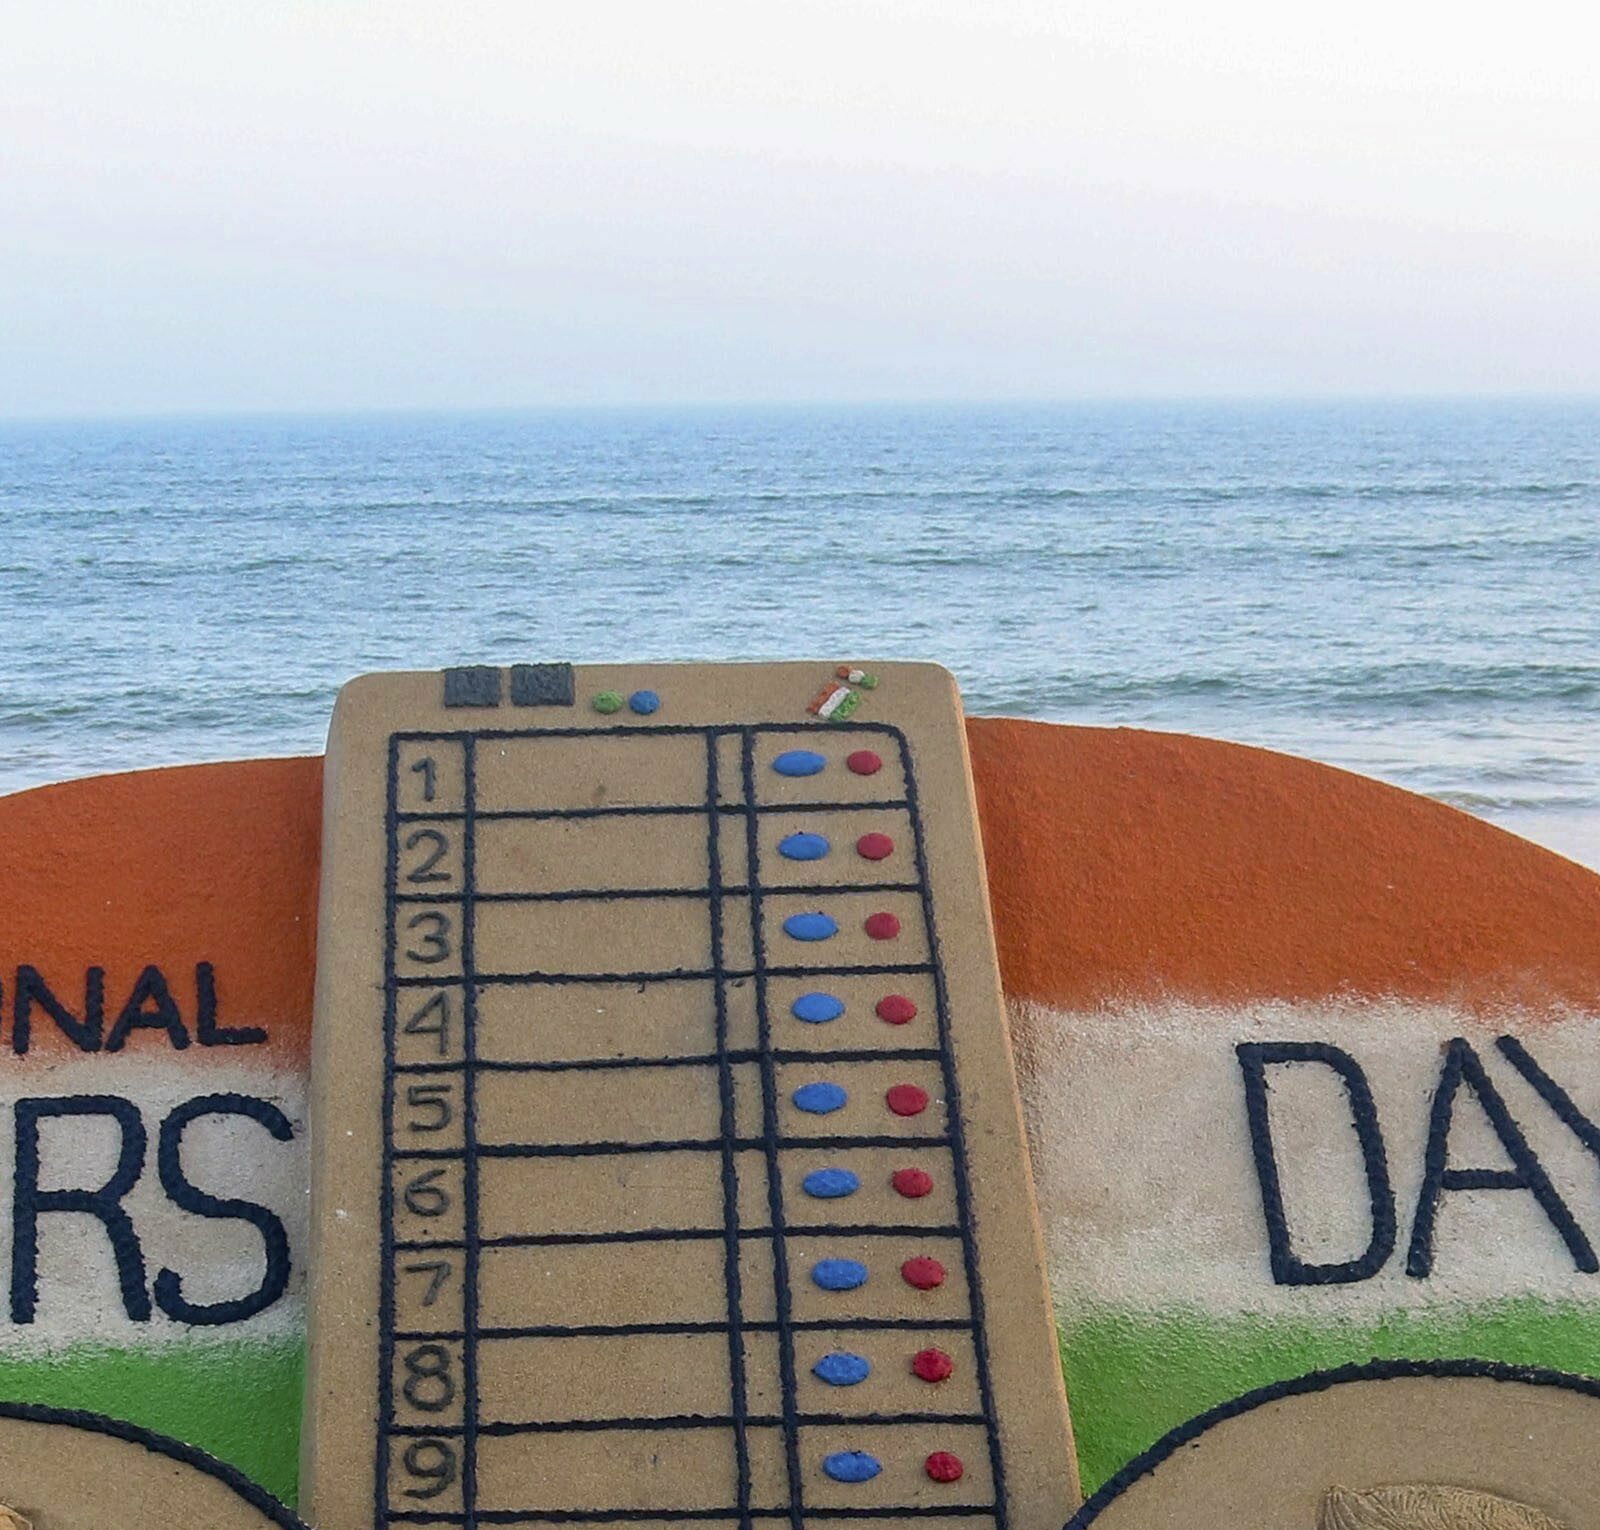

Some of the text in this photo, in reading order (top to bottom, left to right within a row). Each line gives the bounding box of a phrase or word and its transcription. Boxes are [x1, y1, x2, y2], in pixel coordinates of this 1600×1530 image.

[412, 756, 436, 801] 1
[406, 828, 451, 883] 2
[406, 911, 451, 963] 3
[404, 990, 450, 1055] 4
[407, 1085, 452, 1131] 5
[404, 1168, 449, 1217] 6
[405, 1261, 452, 1307] 7
[403, 1344, 455, 1412] 8
[403, 1438, 456, 1499] 9
